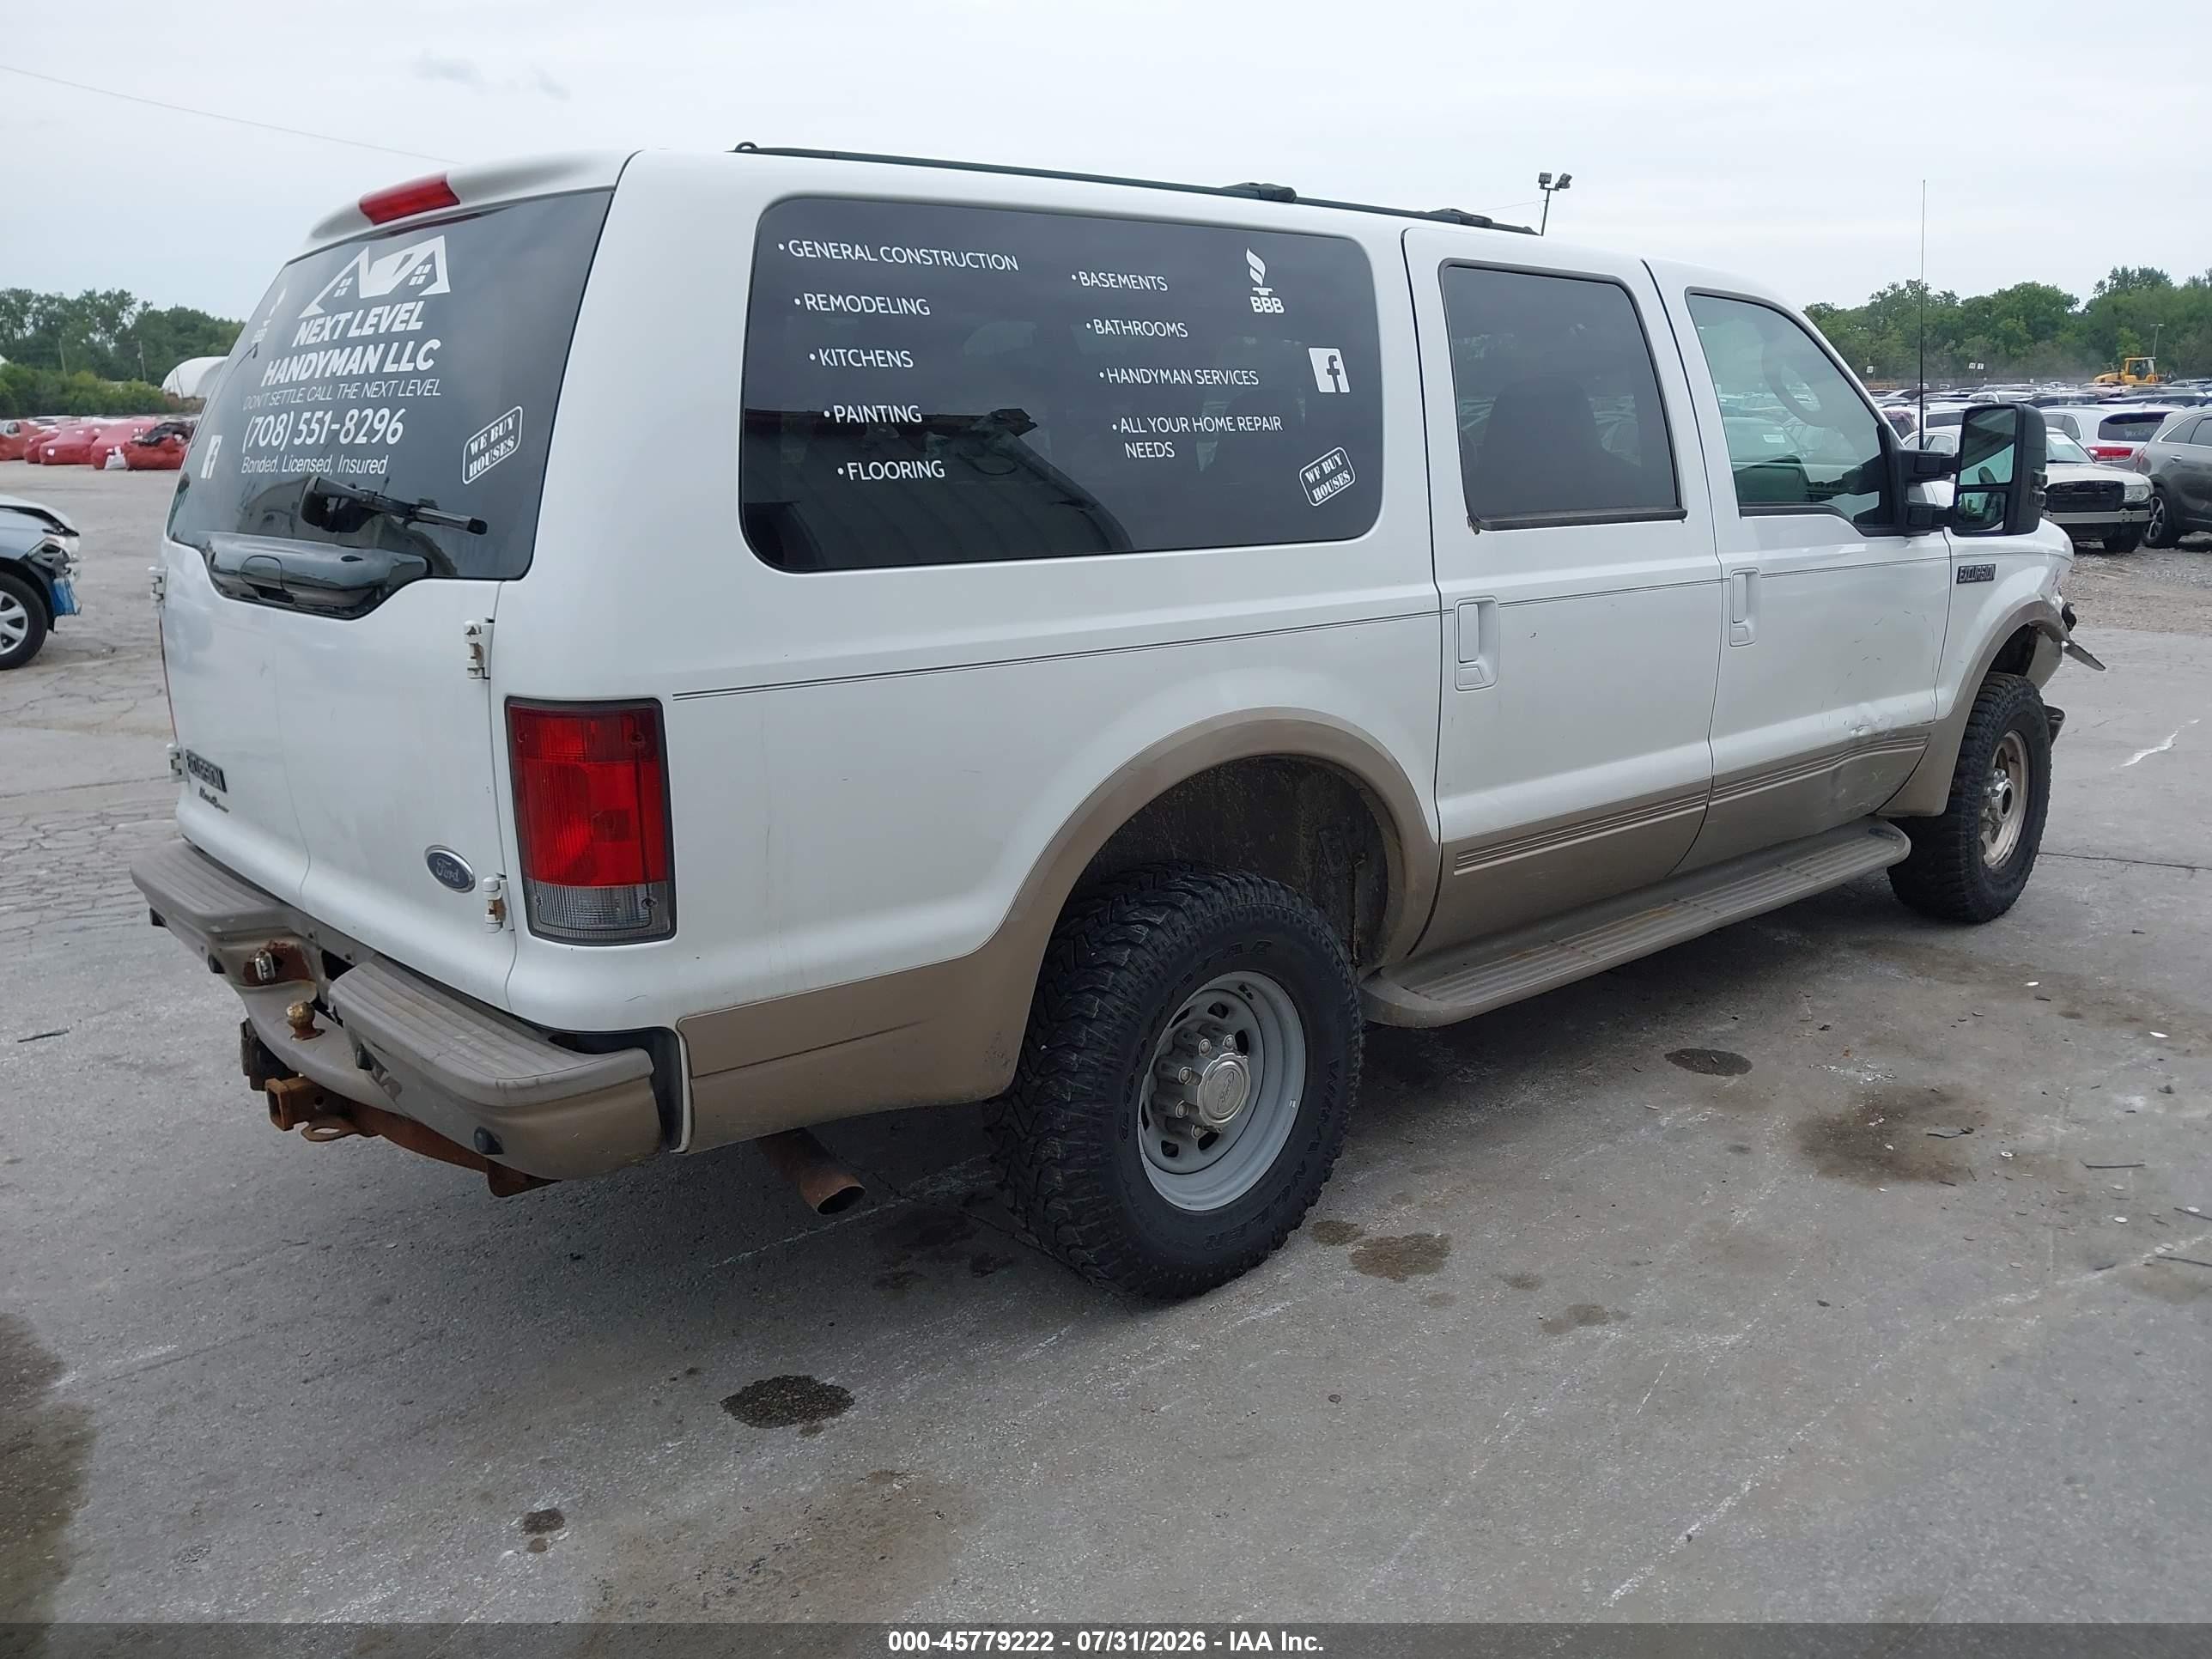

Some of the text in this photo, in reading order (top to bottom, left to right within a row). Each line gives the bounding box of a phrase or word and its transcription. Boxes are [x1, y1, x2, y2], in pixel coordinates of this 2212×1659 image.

[788, 240, 1019, 270] GENERAL CONSTRUCTION
[1079, 271, 1168, 291] BASEMENTS
[804, 293, 931, 315] REMODELING
[1249, 296, 1285, 313] BBB
[291, 301, 425, 348] NEXT LEVEL
[1093, 319, 1188, 337] BATHROOMS
[260, 338, 441, 386] HANDYMAN LLC
[818, 349, 914, 368] KITCHENS
[1106, 368, 1259, 386] HANDYMAN SERVICES
[307, 384, 333, 401] CALL
[337, 382, 359, 399] THE
[361, 380, 399, 398] NEXT
[398, 379, 441, 397] LEVEL
[833, 404, 922, 423] PAINTING
[242, 408, 406, 453] (708) 551-8296
[470, 414, 515, 456] WE BUY
[1120, 416, 1283, 434] ALL YOUR HOME REPAIR
[469, 434, 515, 478] HOUSES
[1125, 441, 1175, 459] NEEDS
[282, 454, 333, 477] Licensed,
[337, 454, 389, 475] Insured
[847, 459, 945, 481] FLOORING
[1322, 453, 1342, 474] BUY
[1312, 470, 1351, 501] HOUSES
